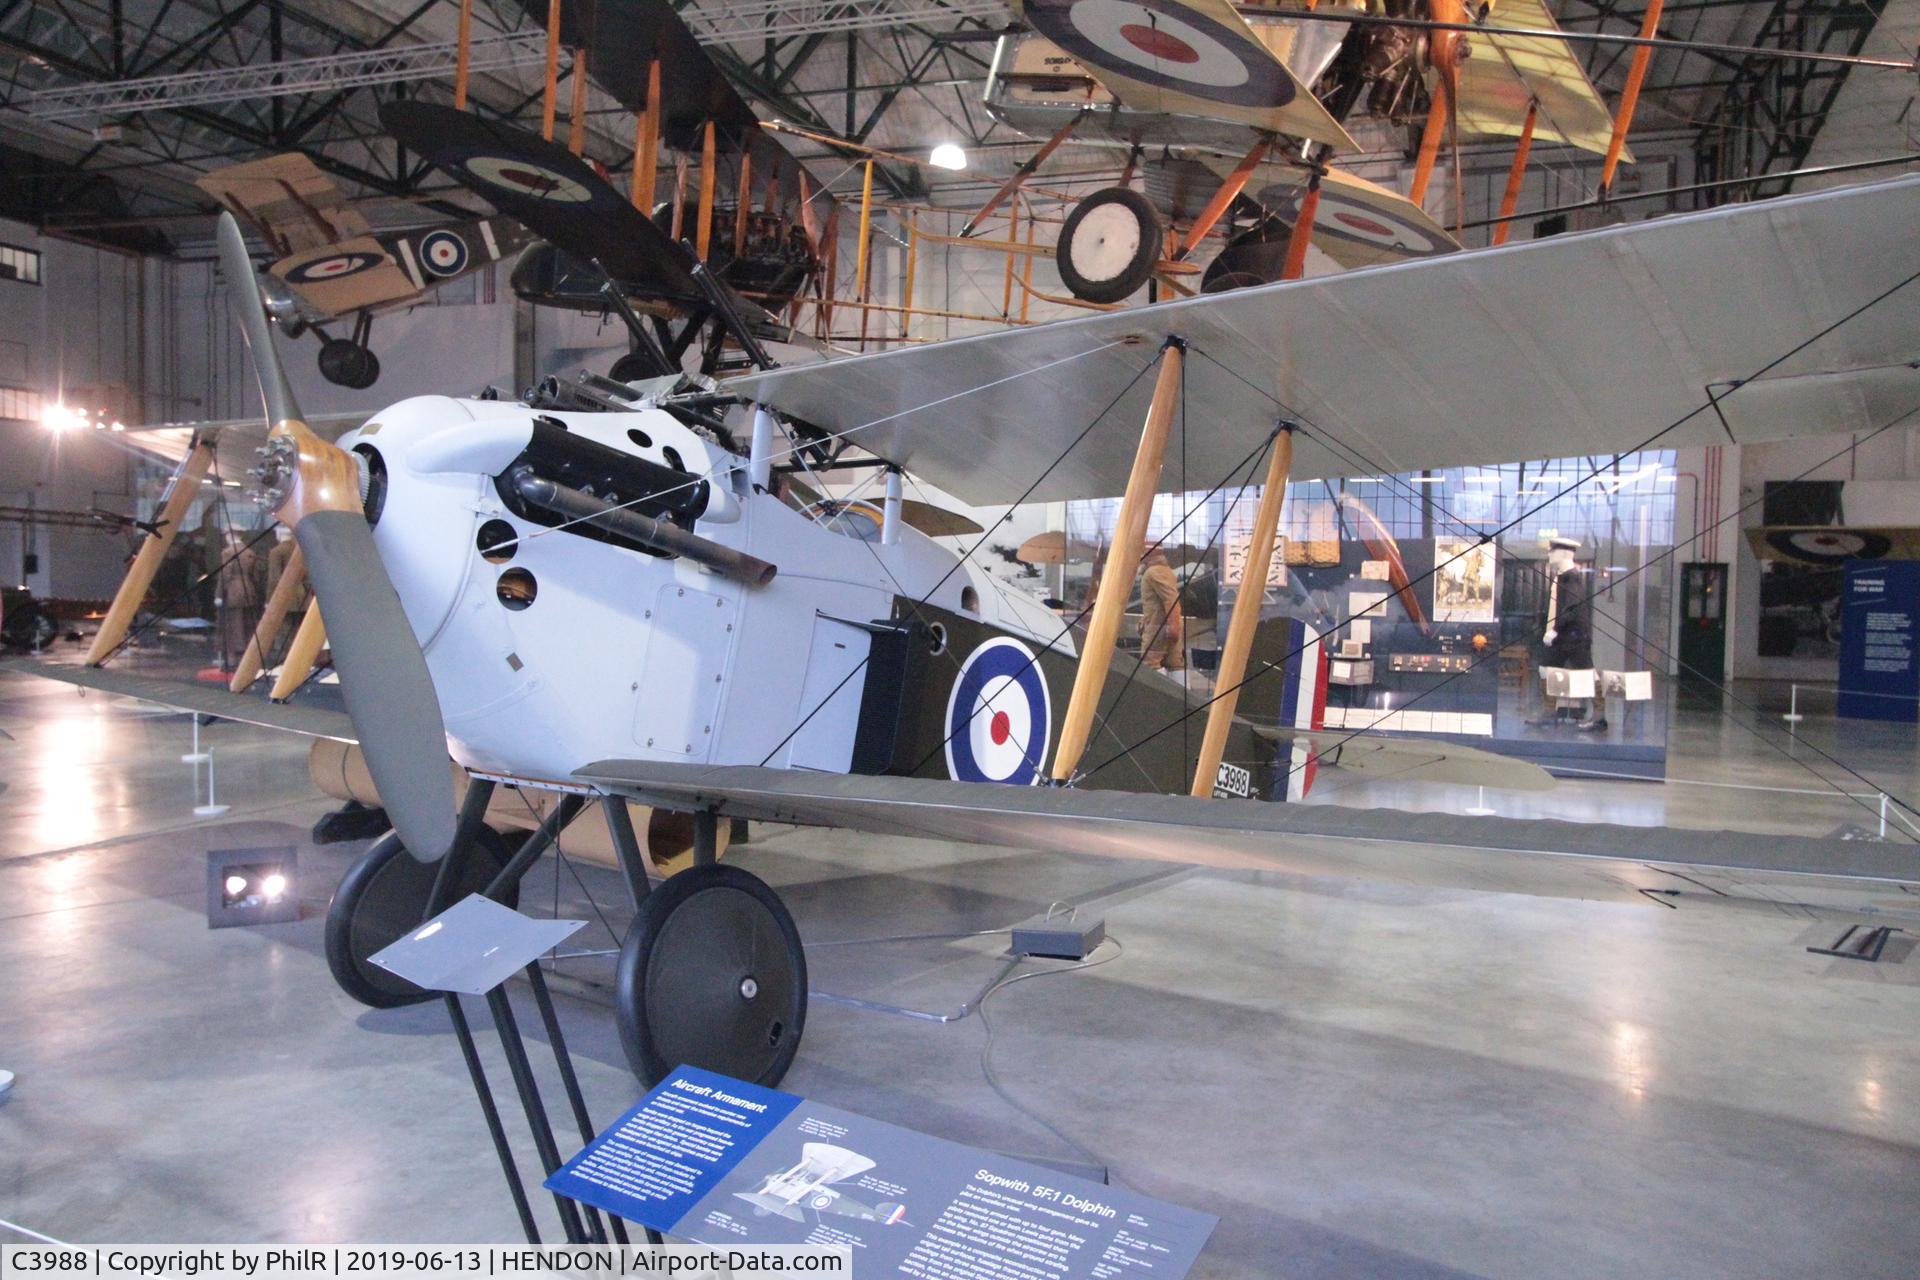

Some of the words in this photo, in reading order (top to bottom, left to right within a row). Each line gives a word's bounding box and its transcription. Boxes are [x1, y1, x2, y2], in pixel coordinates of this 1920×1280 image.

[1216, 764, 1247, 793] C3988
[671, 1079, 713, 1097] Aircraft
[710, 1090, 767, 1113] Armament
[974, 1169, 1030, 1193] Sopwith
[1032, 1185, 1061, 1202] 5F.1
[1061, 1194, 1116, 1218] Dolphin
